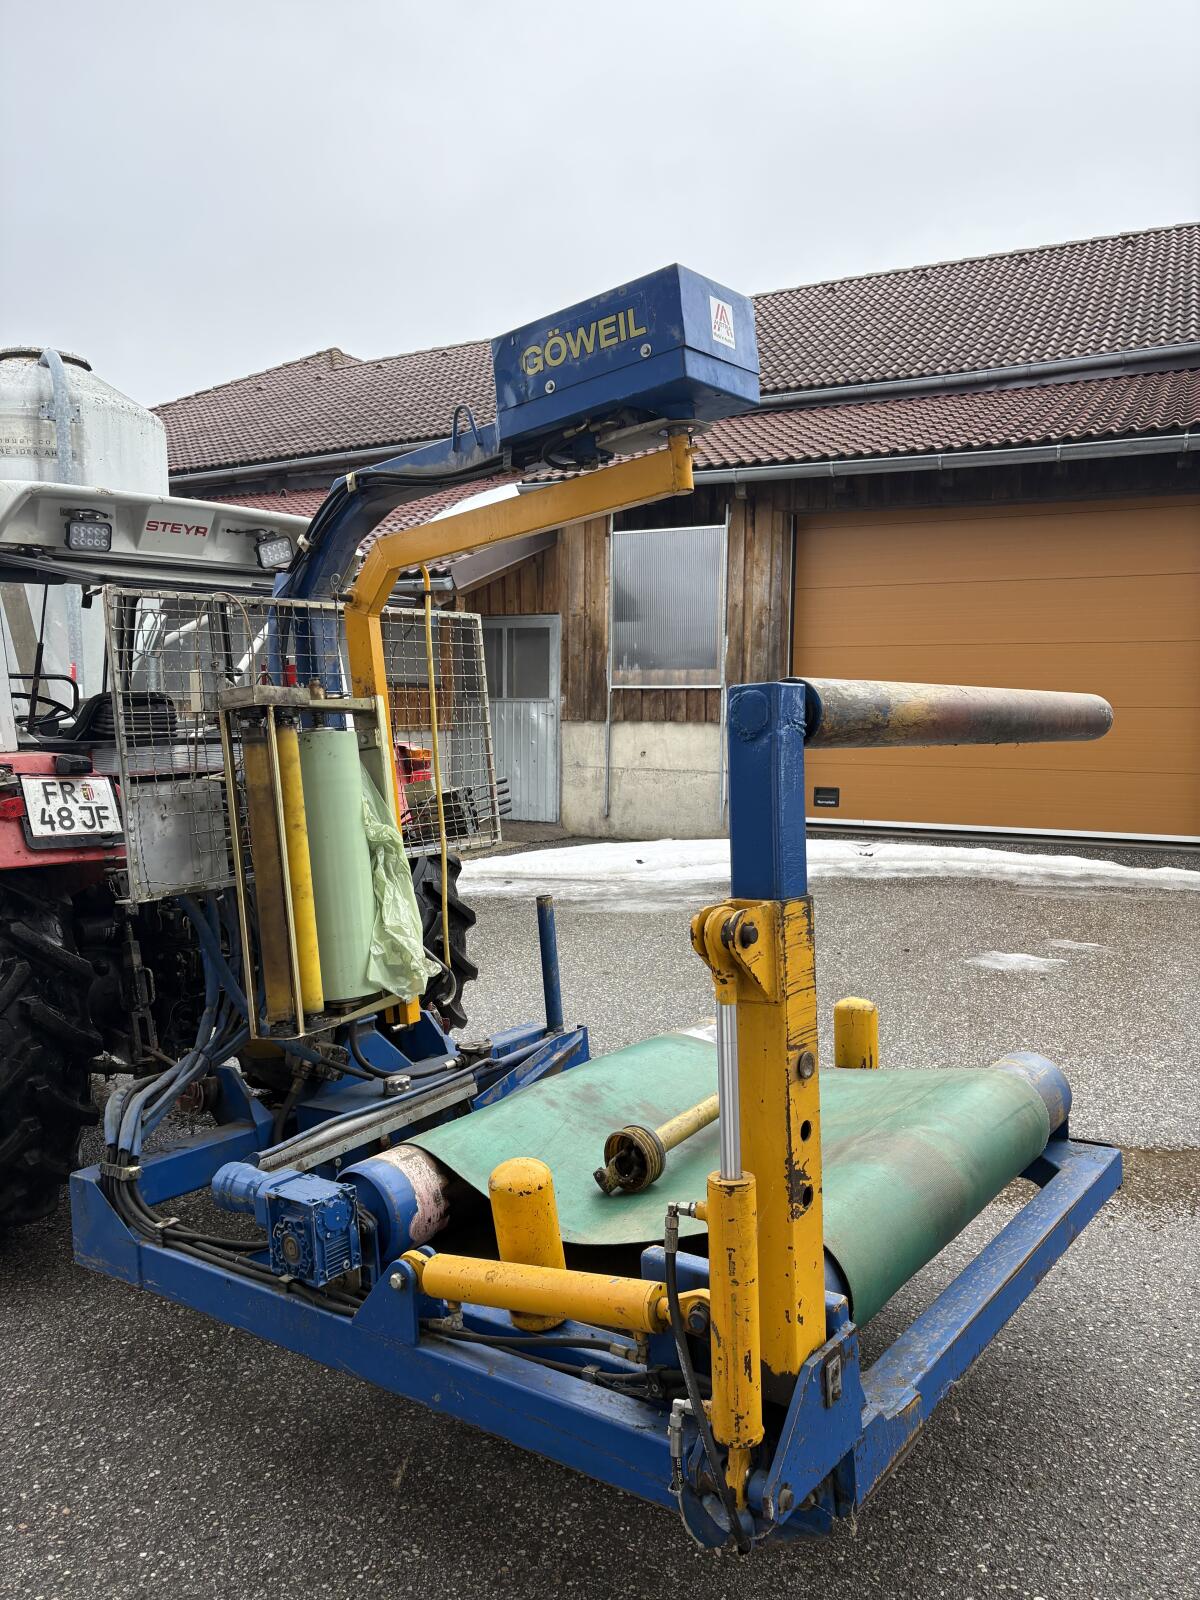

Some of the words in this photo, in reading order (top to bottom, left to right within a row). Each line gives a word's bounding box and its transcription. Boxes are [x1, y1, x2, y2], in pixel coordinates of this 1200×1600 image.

[521, 307, 647, 376] GÖWEIL
[145, 520, 208, 537] STEYR
[41, 781, 79, 805] FR
[40, 806, 76, 832] 48
[78, 805, 110, 830] JF
